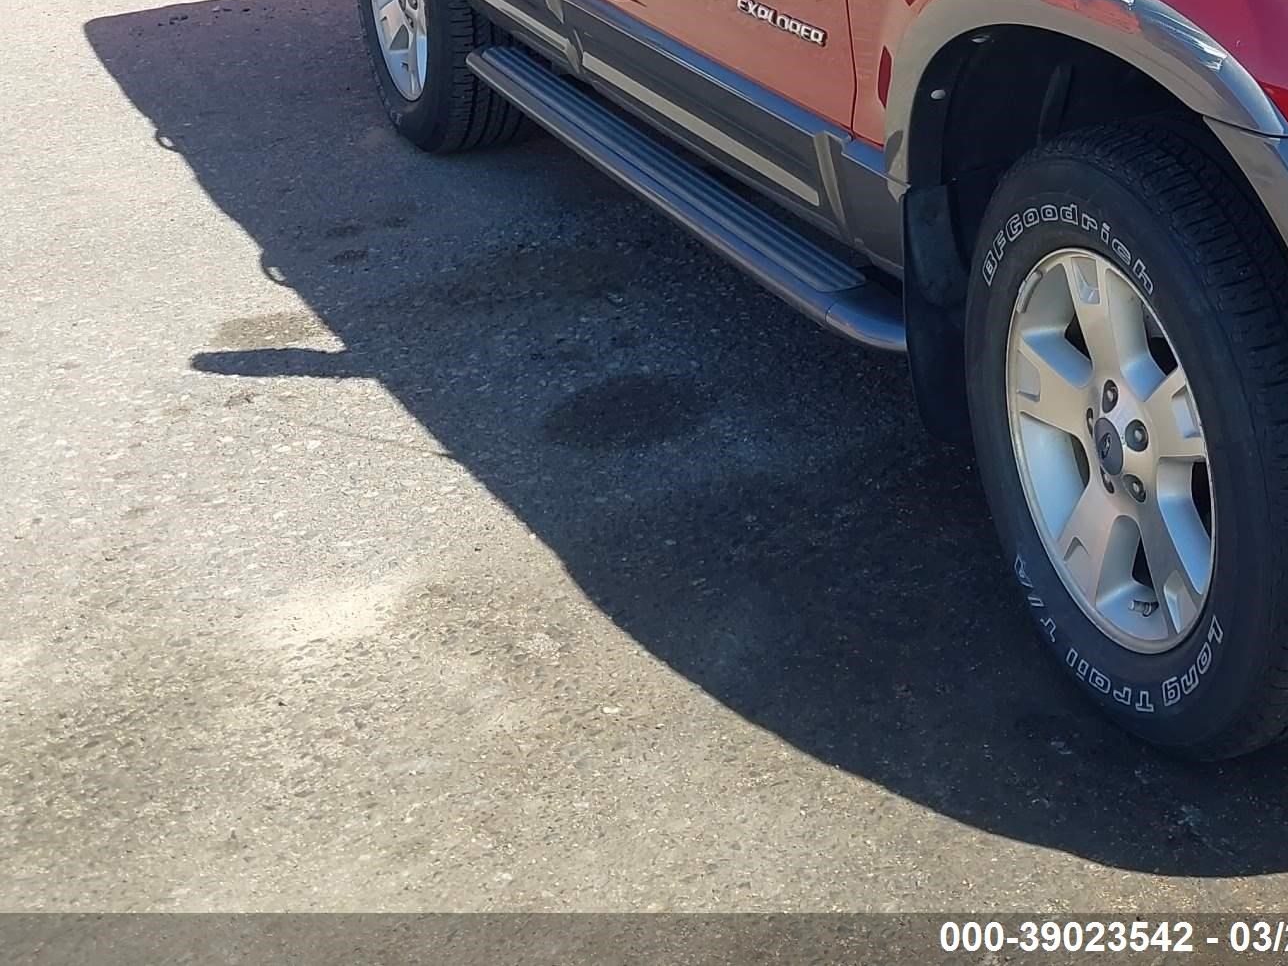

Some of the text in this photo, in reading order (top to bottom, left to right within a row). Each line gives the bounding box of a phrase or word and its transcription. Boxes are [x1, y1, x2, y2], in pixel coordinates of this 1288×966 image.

[982, 203, 1155, 296] BFGoodrich
[1065, 647, 1155, 712] Trail
[1162, 614, 1224, 706] Long
